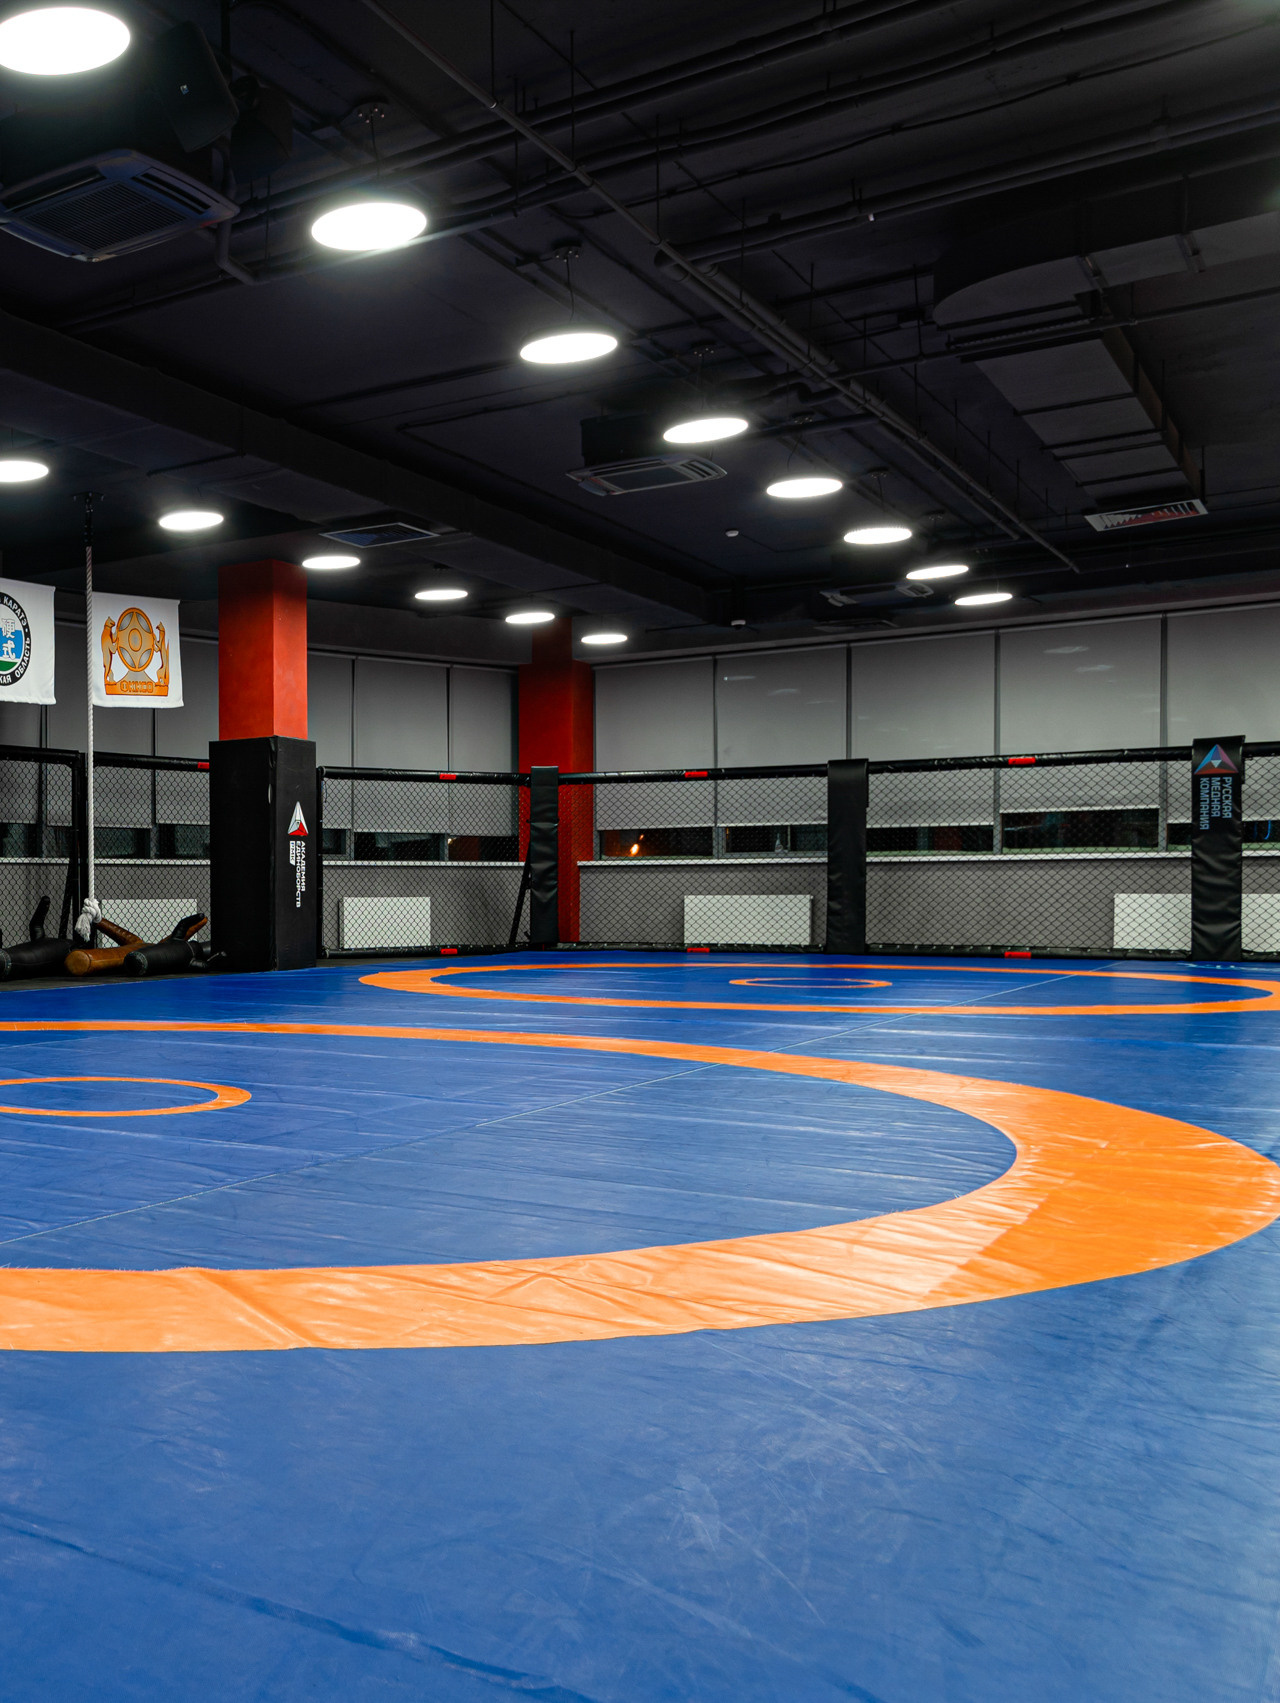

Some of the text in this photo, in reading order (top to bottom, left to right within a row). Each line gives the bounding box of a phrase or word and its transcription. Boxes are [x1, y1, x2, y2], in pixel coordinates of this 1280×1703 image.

[3, 595, 27, 626] КАРАТЭ
[14, 637, 31, 678] ОБЛАСТЬ
[1199, 777, 1210, 830] КОМПАНИЯ
[1211, 777, 1221, 817] МЕДНАЯ
[1222, 776, 1232, 819] РУССКАЯ
